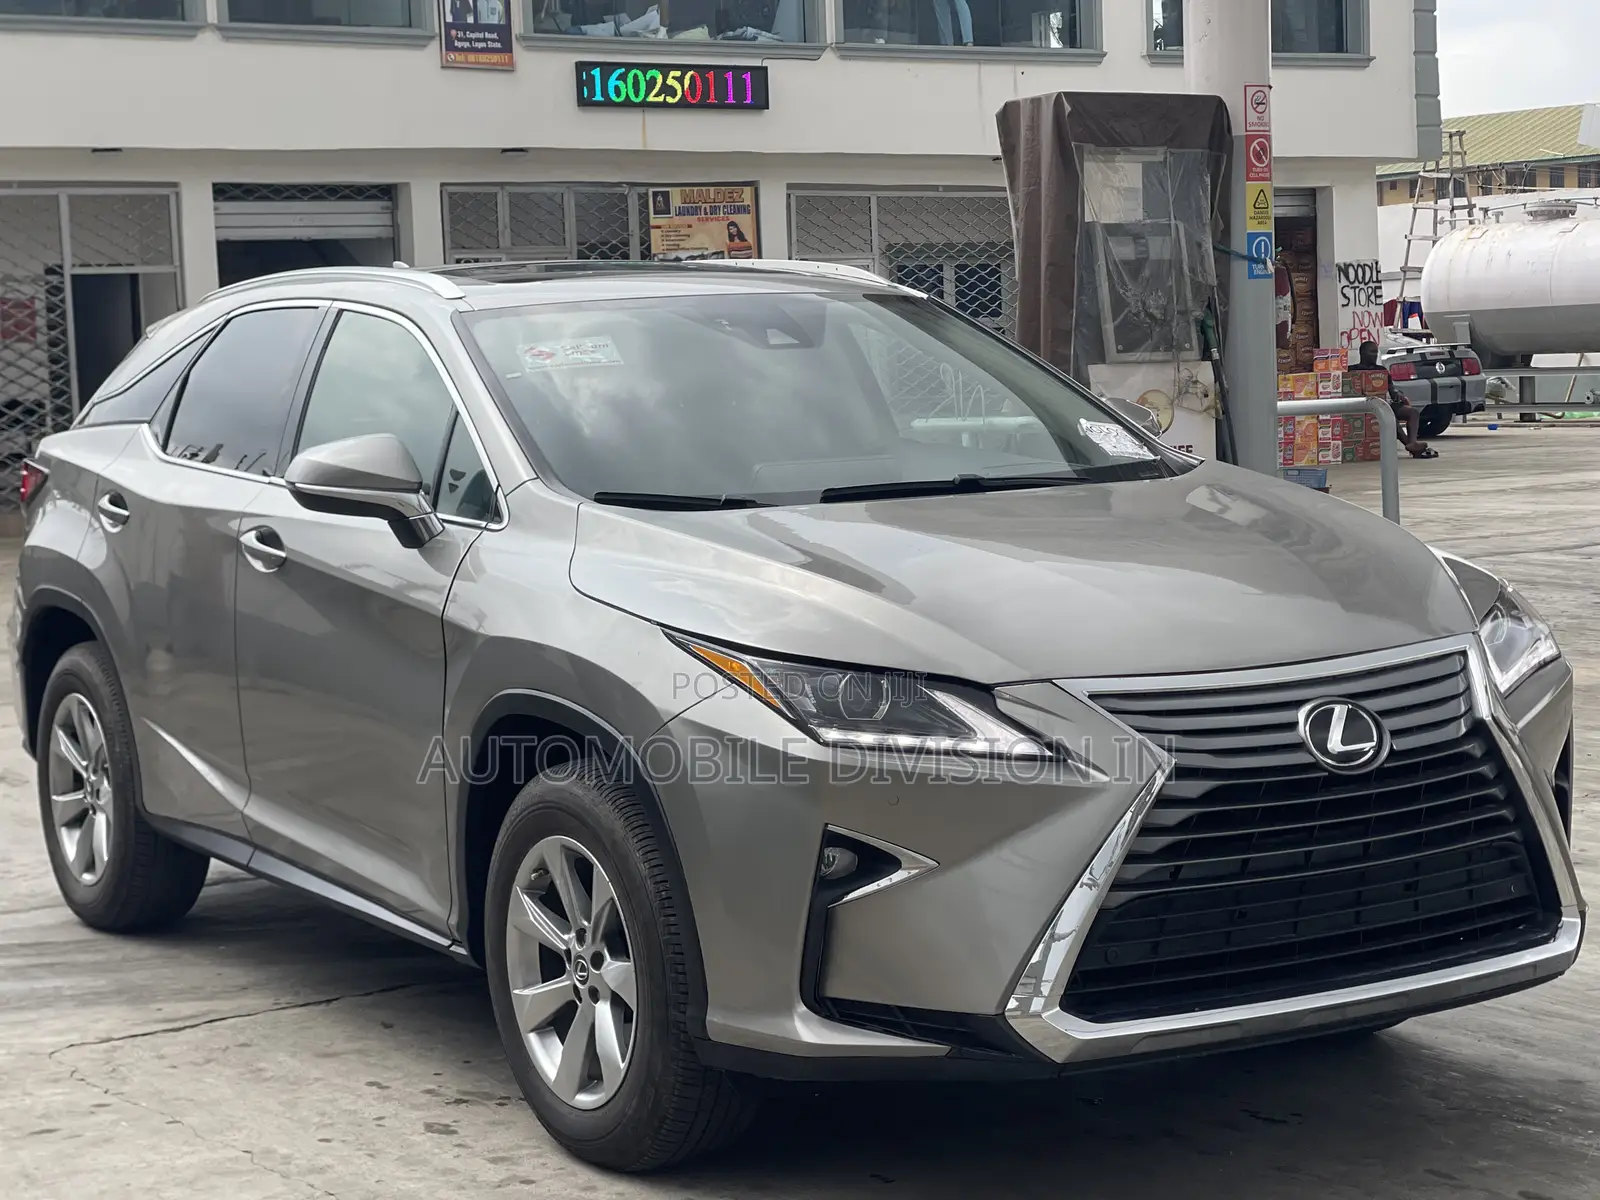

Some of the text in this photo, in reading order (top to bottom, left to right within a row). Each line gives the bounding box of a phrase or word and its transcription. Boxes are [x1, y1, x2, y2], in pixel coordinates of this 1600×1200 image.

[583, 67, 754, 103] 160250111
[680, 188, 744, 204] MALDEZ
[674, 204, 751, 216] LAUNDRY & DRY CLEANING
[1336, 260, 1381, 285] NOODLE
[1341, 285, 1383, 307] STORE
[1352, 310, 1383, 329] NOW
[1340, 327, 1380, 349] OPEN
